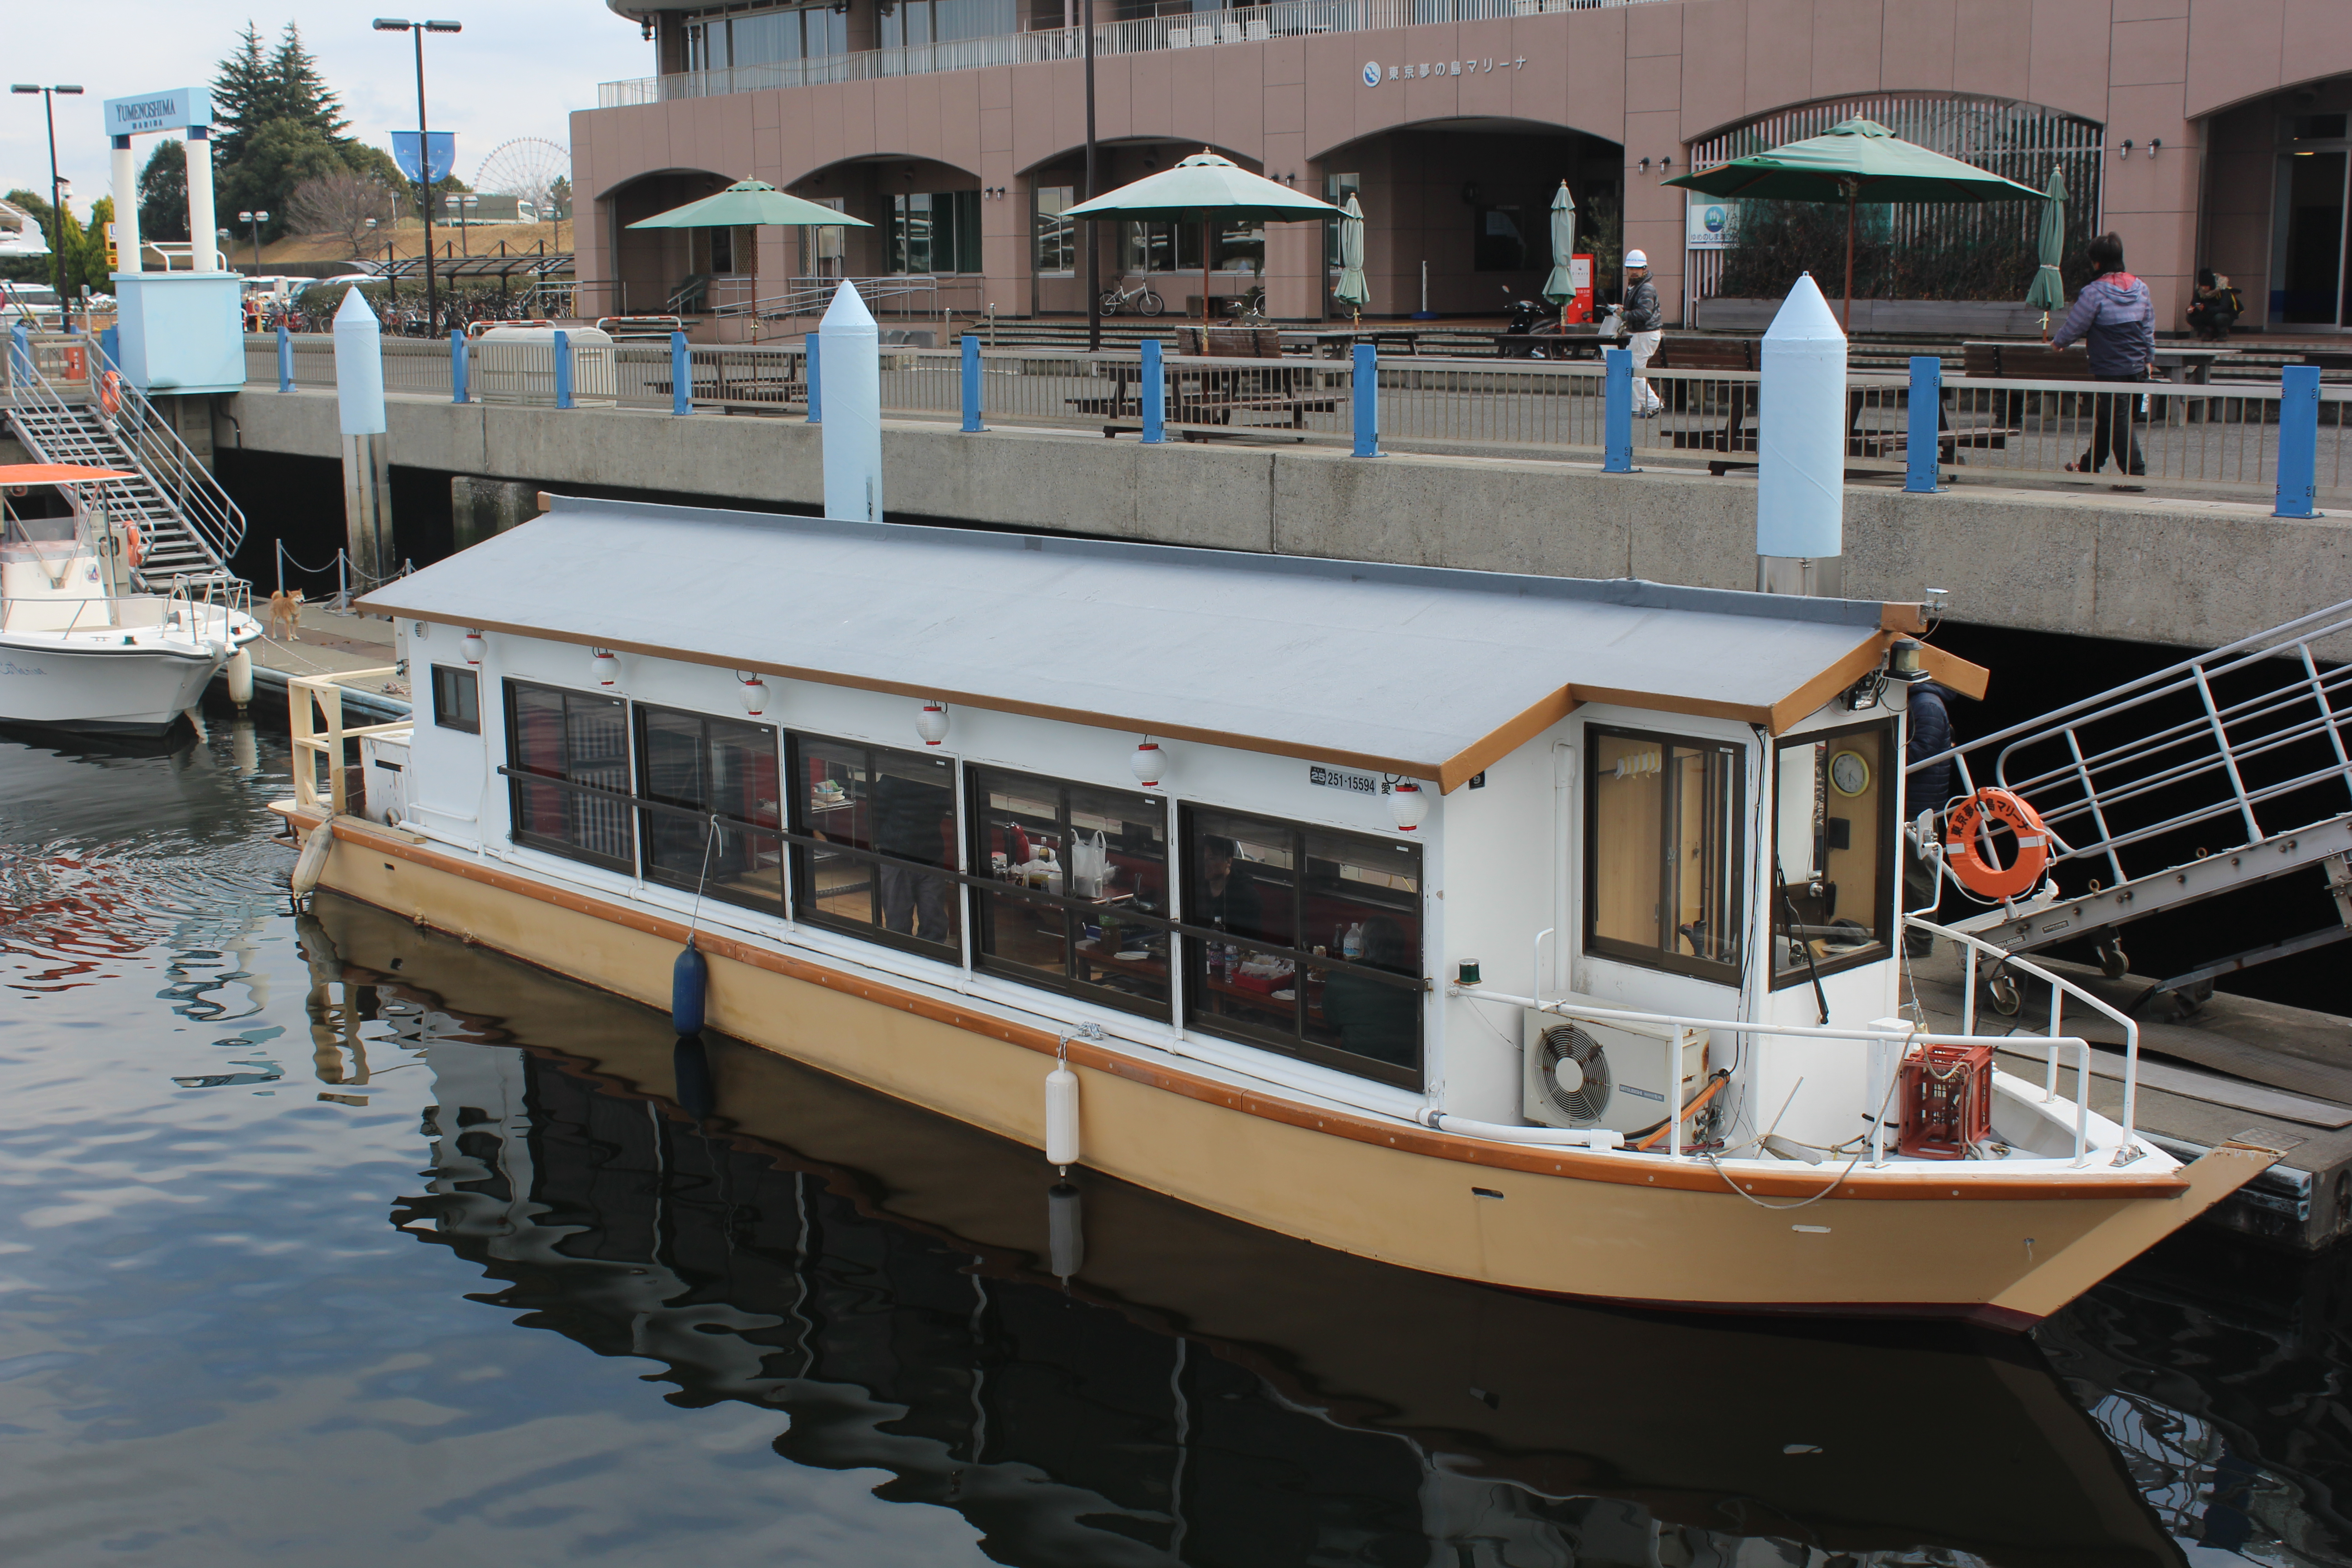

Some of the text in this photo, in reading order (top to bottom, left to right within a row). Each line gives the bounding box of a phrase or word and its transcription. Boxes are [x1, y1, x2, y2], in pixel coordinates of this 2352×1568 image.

[1388, 55, 1527, 81] 東京夢の島マリーナ
[116, 98, 176, 122] YUMENOSHIMA
[132, 119, 163, 130] MARINA
[1311, 771, 1326, 782] 25
[1473, 775, 1481, 784] 9
[1381, 782, 1391, 795] 愛
